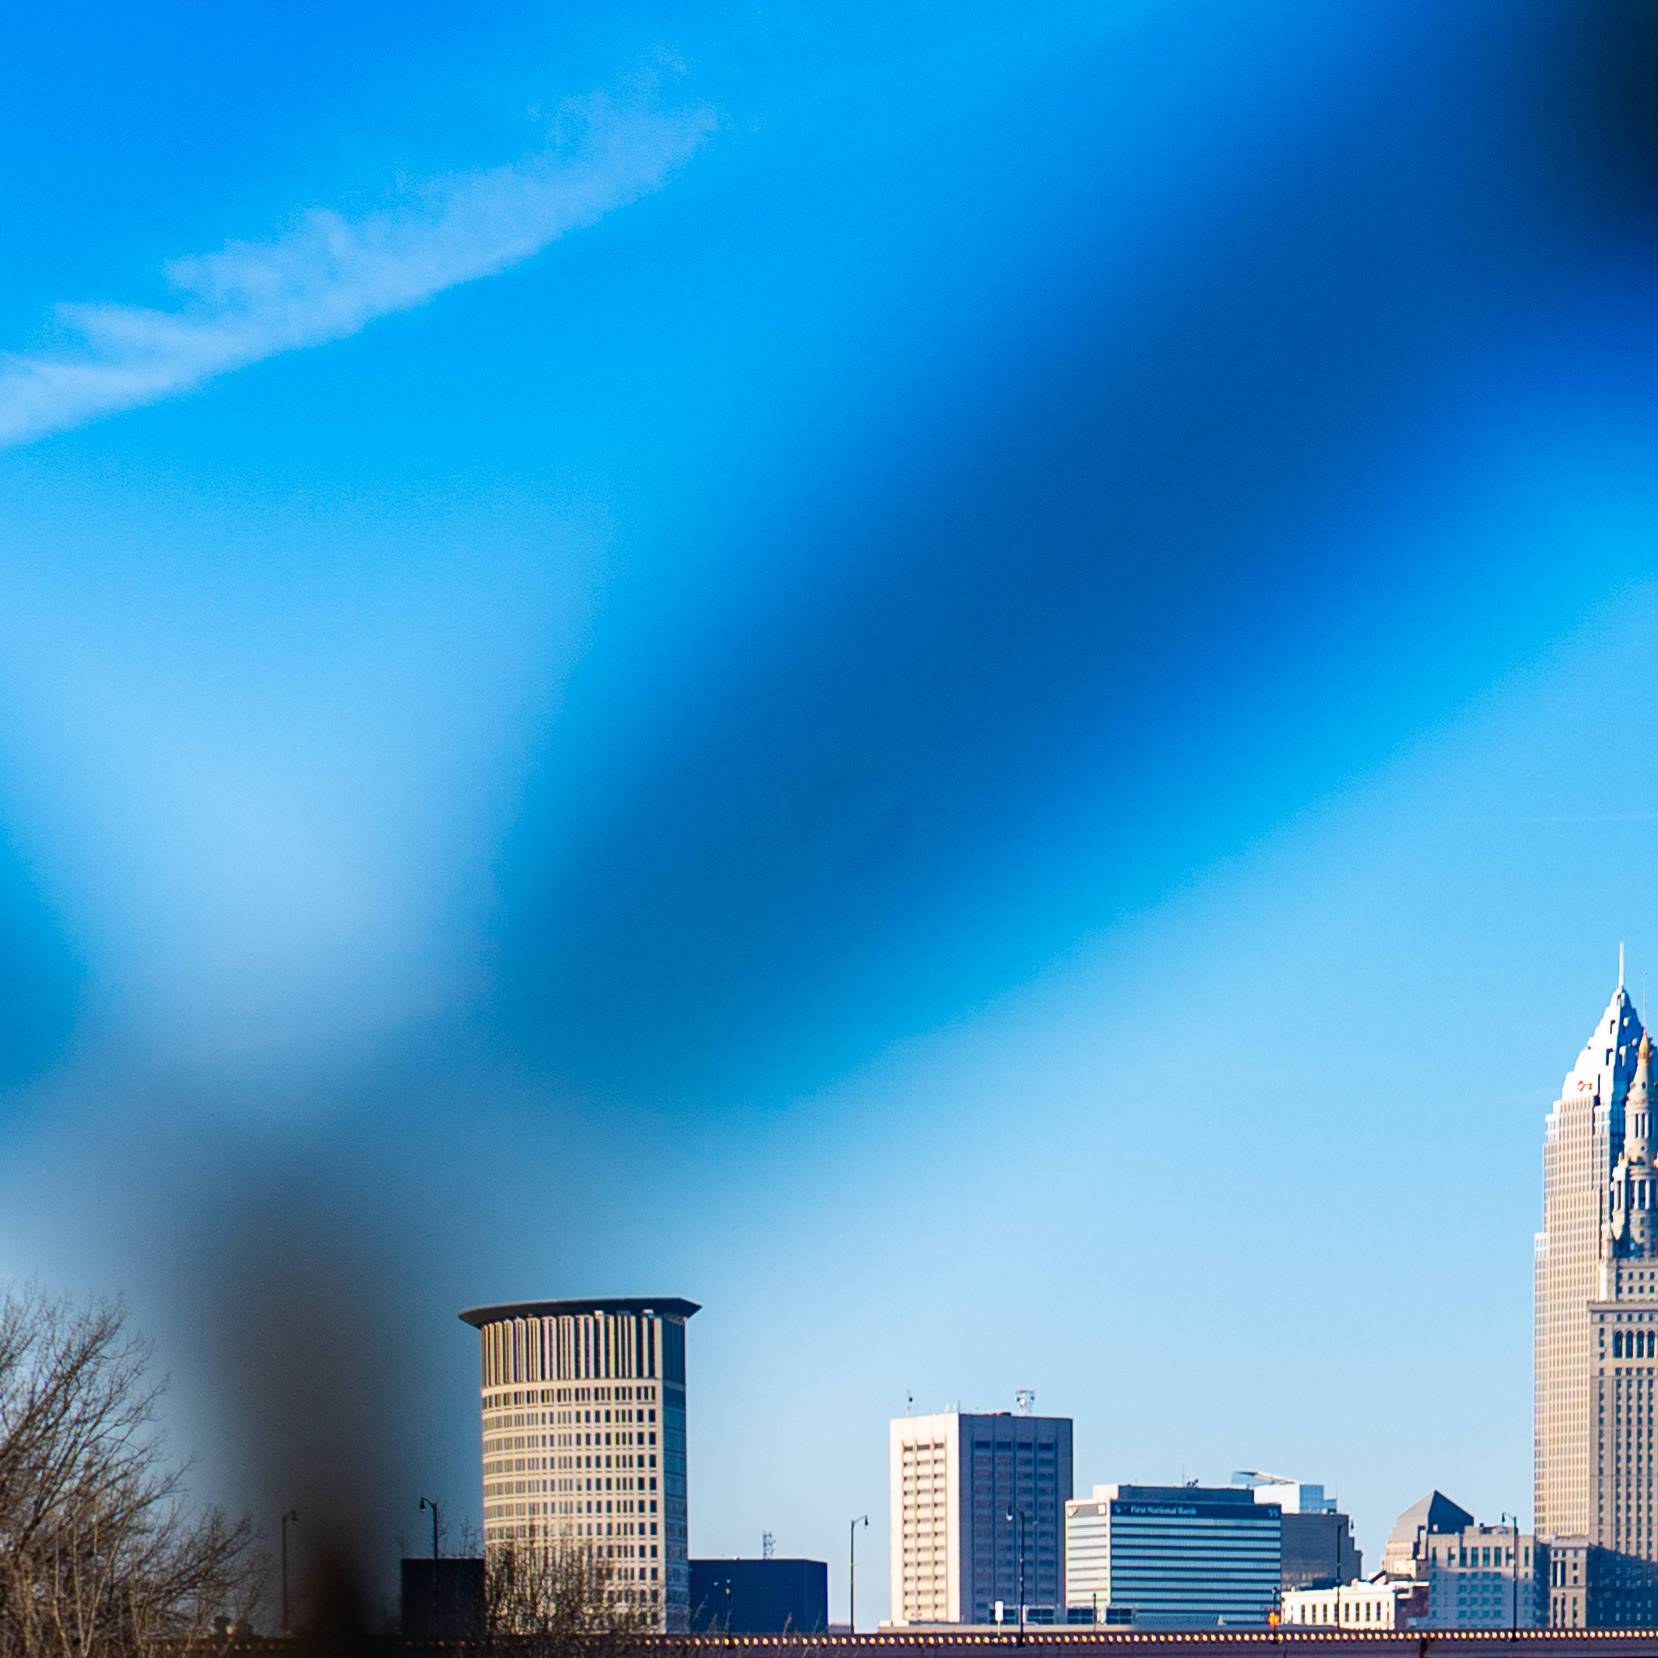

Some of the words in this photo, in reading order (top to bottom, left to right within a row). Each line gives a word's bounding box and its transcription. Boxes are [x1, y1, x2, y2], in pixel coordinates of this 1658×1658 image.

[1131, 1505, 1146, 1514] First
[1147, 1506, 1177, 1515] National
[1178, 1507, 1197, 1515] Bank
